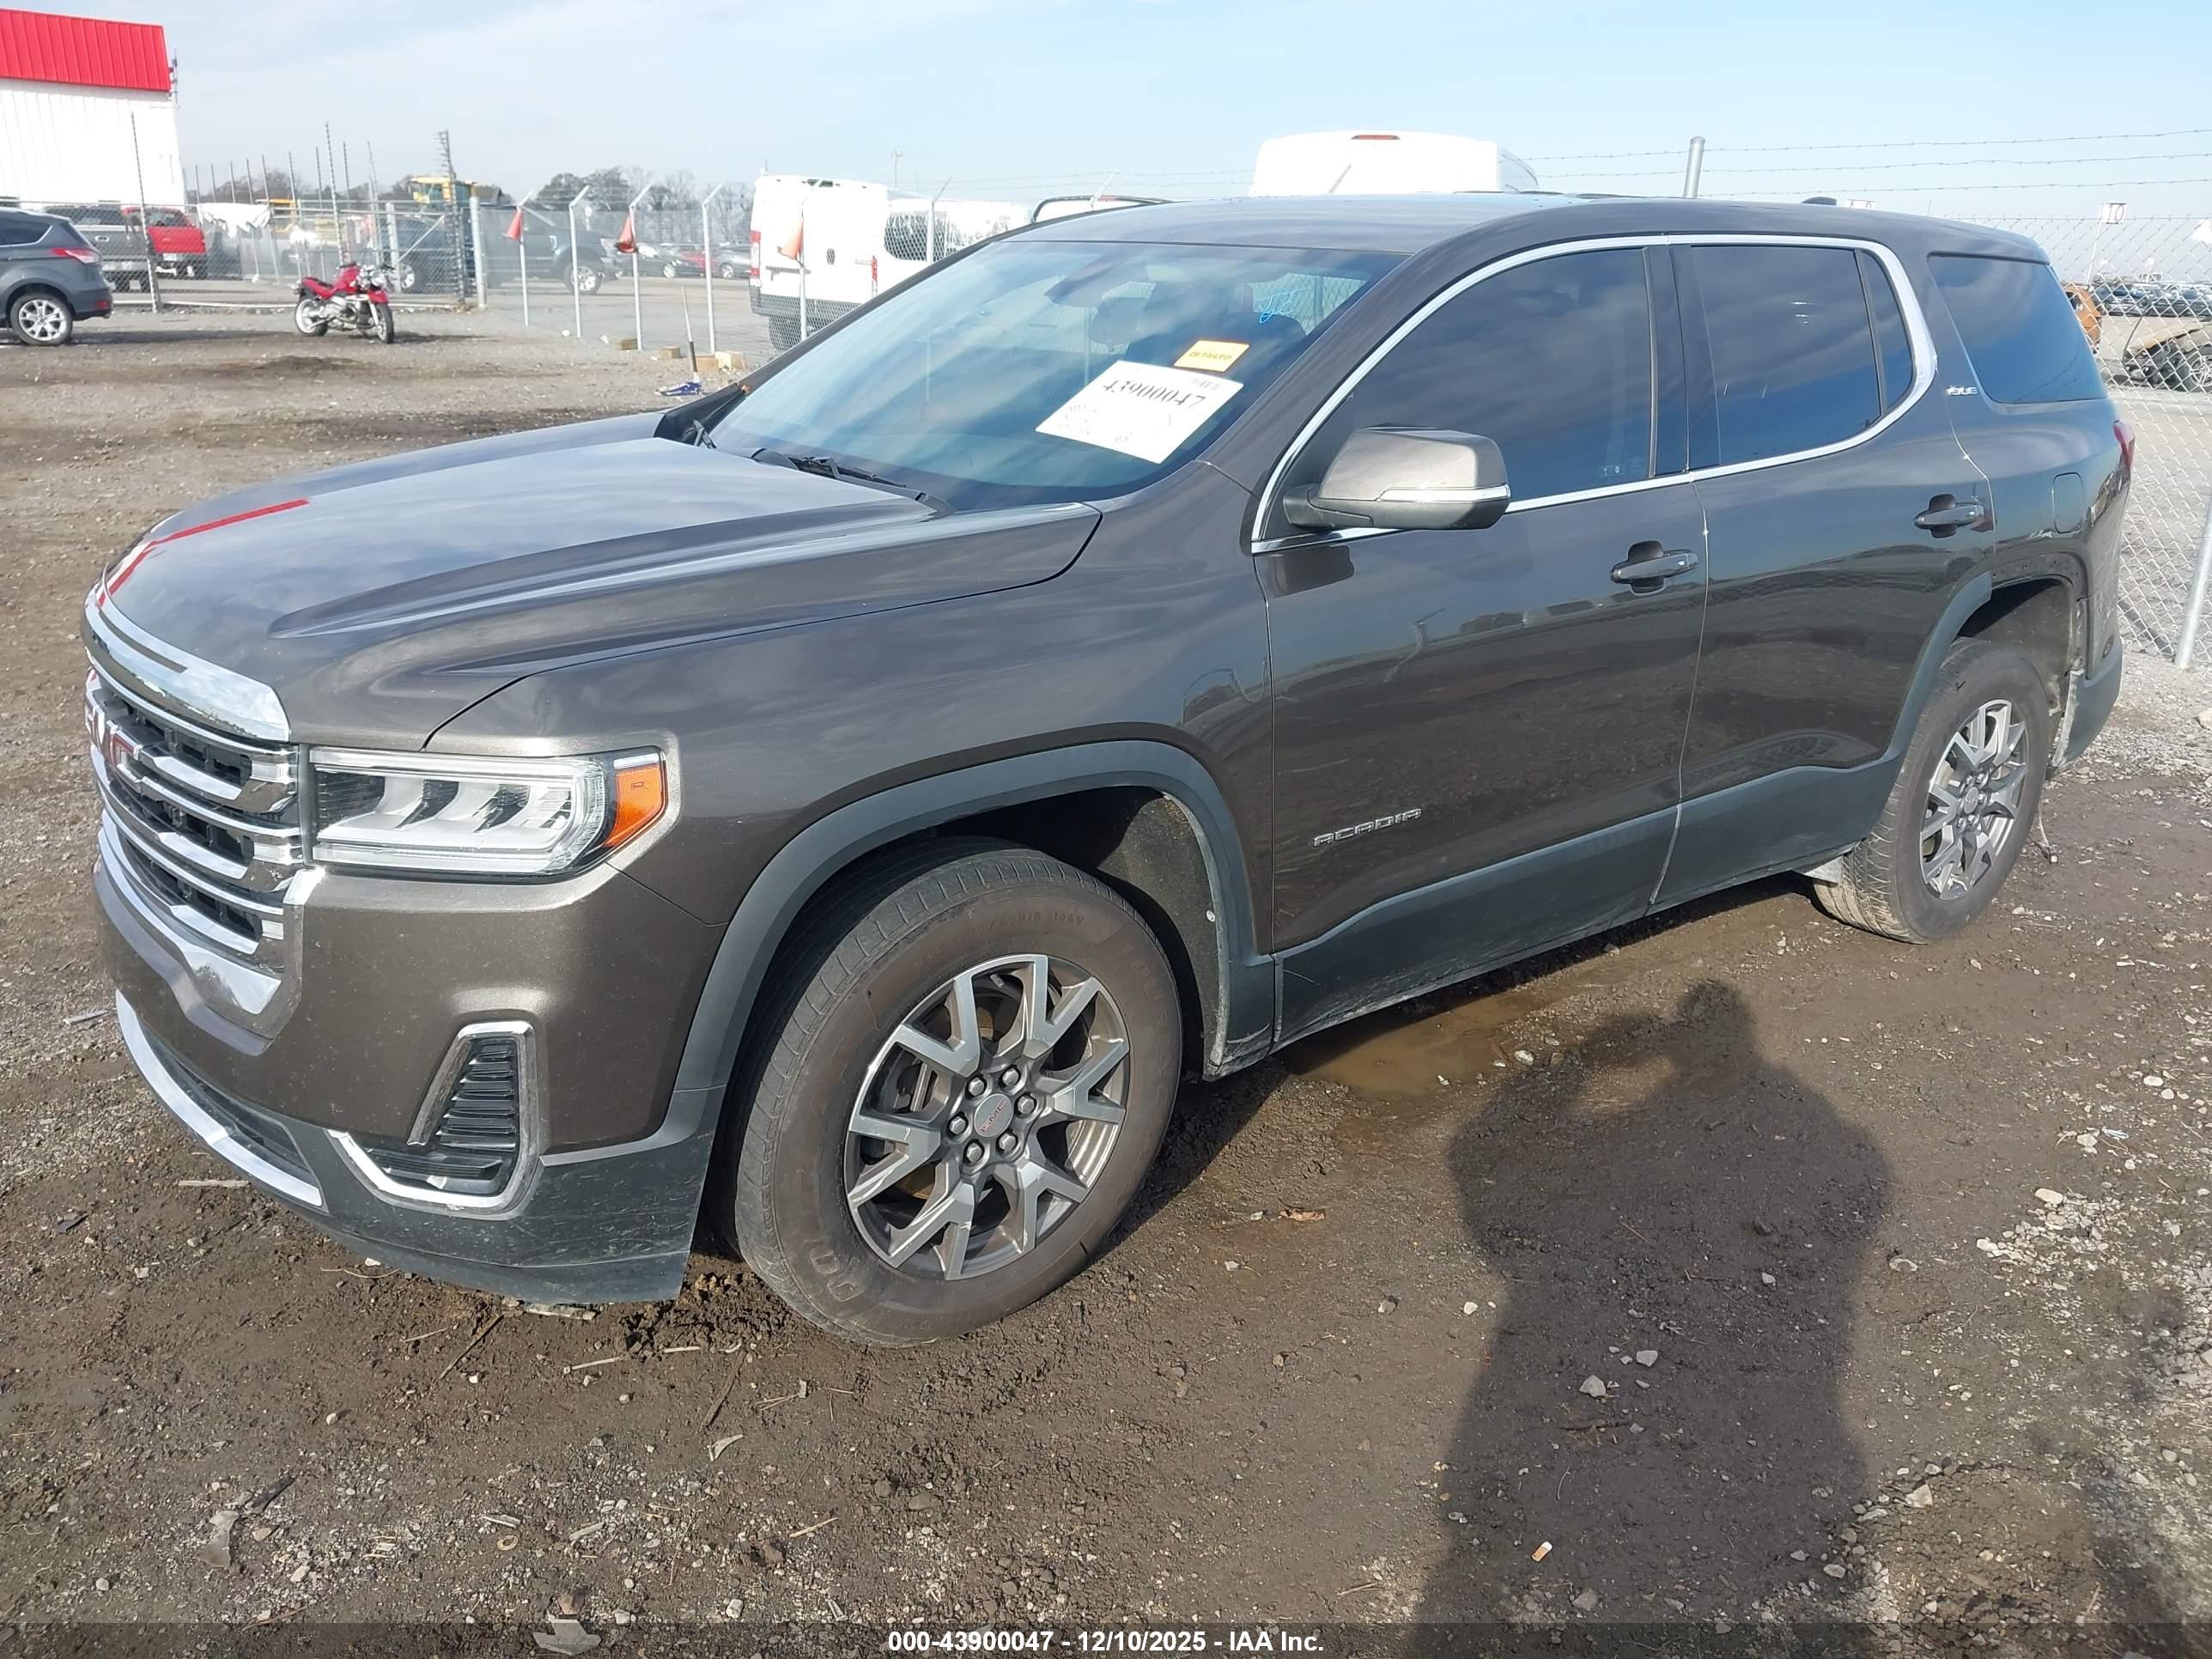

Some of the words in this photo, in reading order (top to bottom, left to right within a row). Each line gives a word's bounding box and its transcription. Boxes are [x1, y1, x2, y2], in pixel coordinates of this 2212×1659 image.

[1188, 351, 1232, 361] DETAILED
[1103, 380, 1206, 409] 43900047
[1313, 808, 1422, 847] ACADIA
[979, 1098, 1008, 1134] GMC
